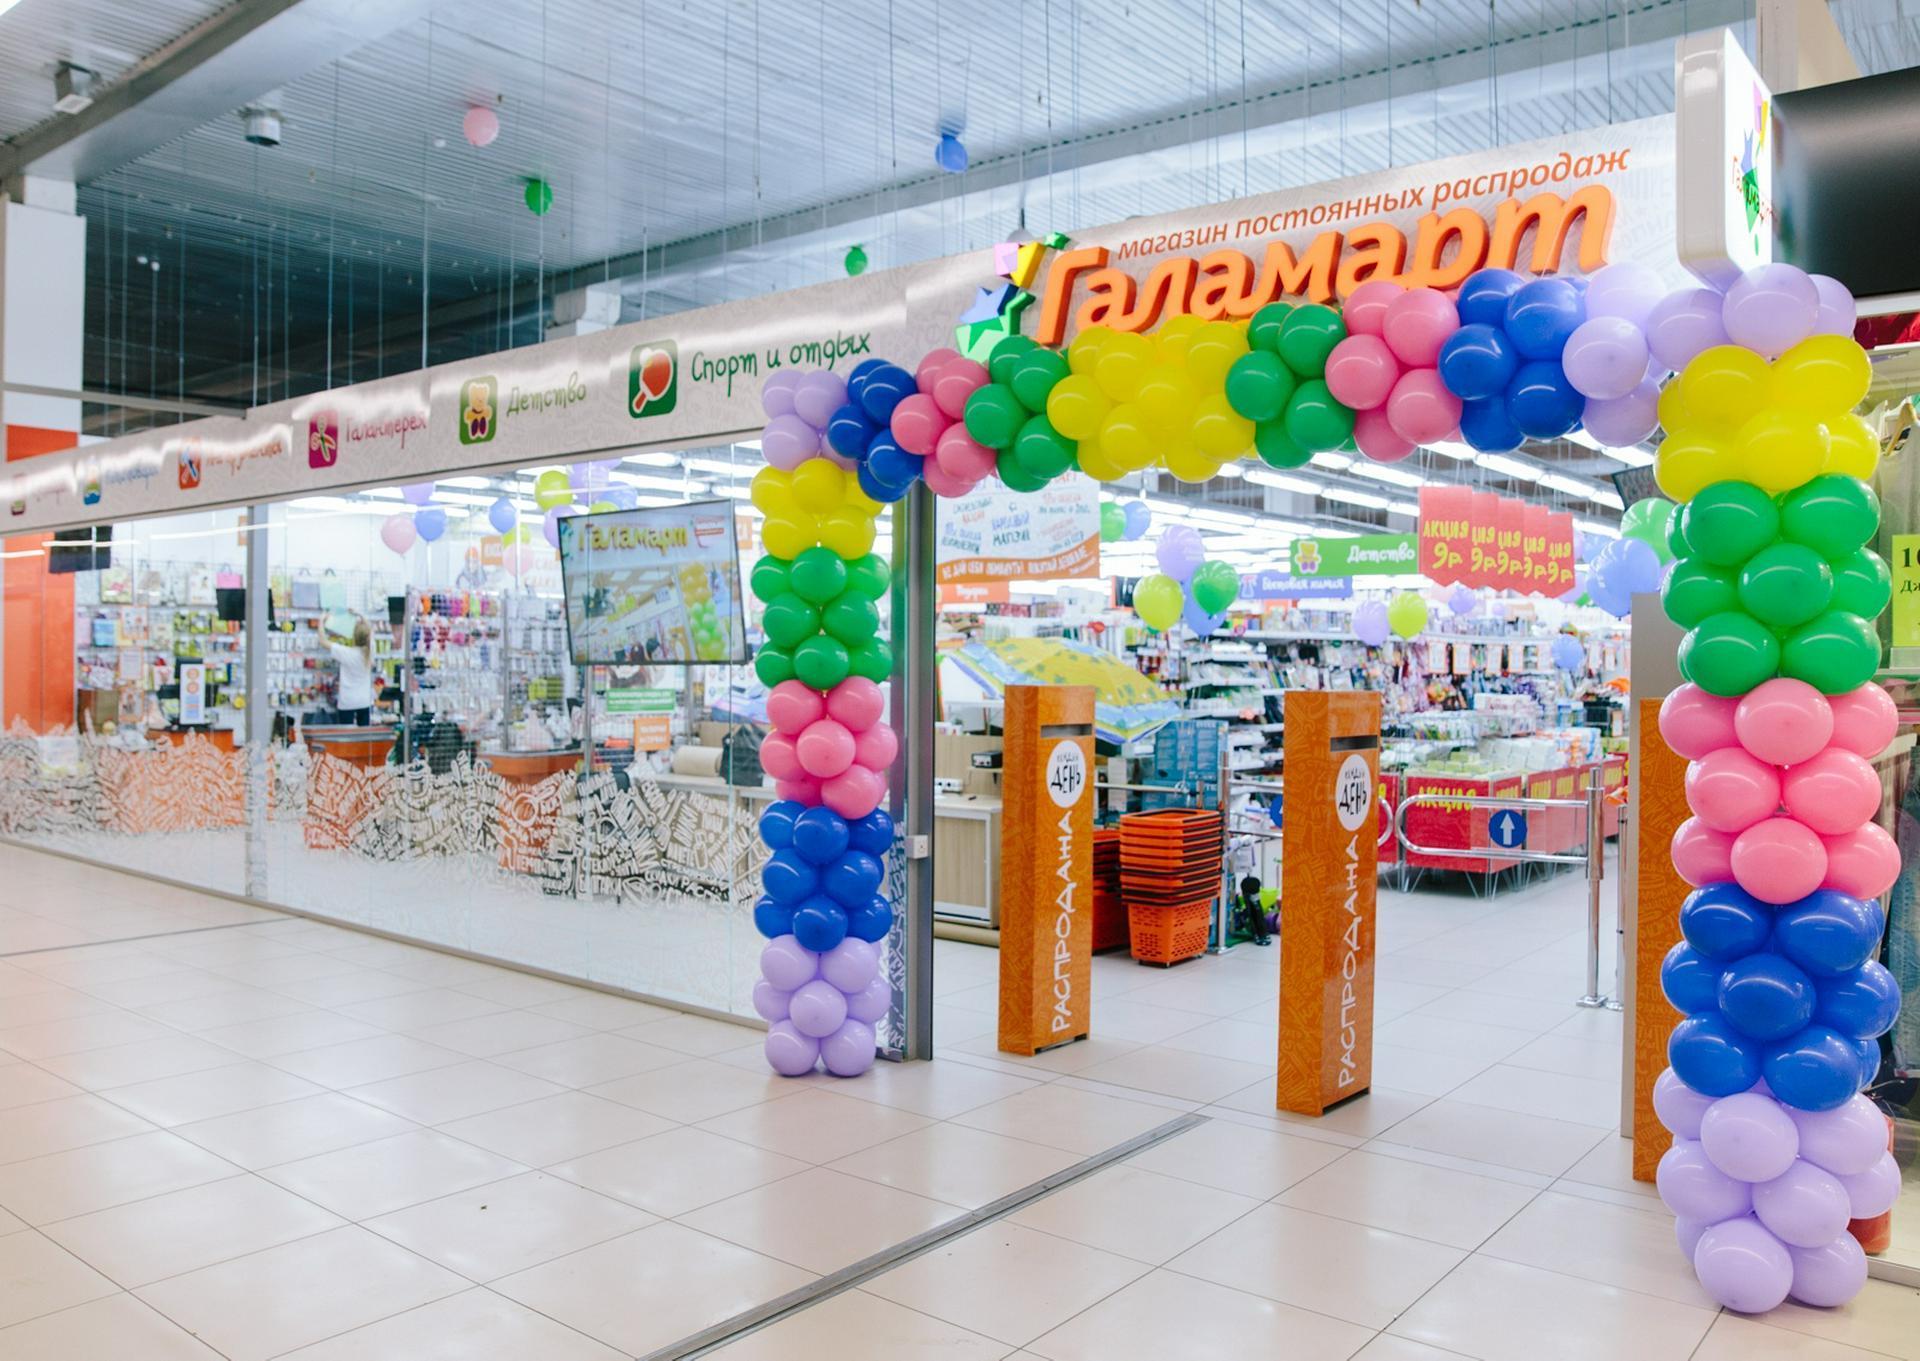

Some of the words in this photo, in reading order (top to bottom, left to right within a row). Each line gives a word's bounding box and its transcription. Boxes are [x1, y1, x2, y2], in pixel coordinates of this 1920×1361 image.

[1117, 222, 1228, 260] магазин
[1235, 184, 1425, 240] постоянных
[1431, 148, 1632, 211] распродаж
[1031, 183, 1618, 348] Галамарт
[691, 350, 758, 398] Спорт
[766, 347, 782, 369] и
[789, 329, 871, 372] отдых
[505, 370, 587, 418] Детство
[577, 523, 689, 557] Галамарт
[1346, 541, 1416, 563] Детство
[1422, 519, 1470, 542] АКЦИЯ
[1050, 764, 1082, 794] ДЕНЬ
[1339, 781, 1367, 816] ДЕНЬ
[1052, 810, 1077, 1033] РАСПРОДАЖА
[1337, 833, 1362, 1089] РАСПРОДАЖА
